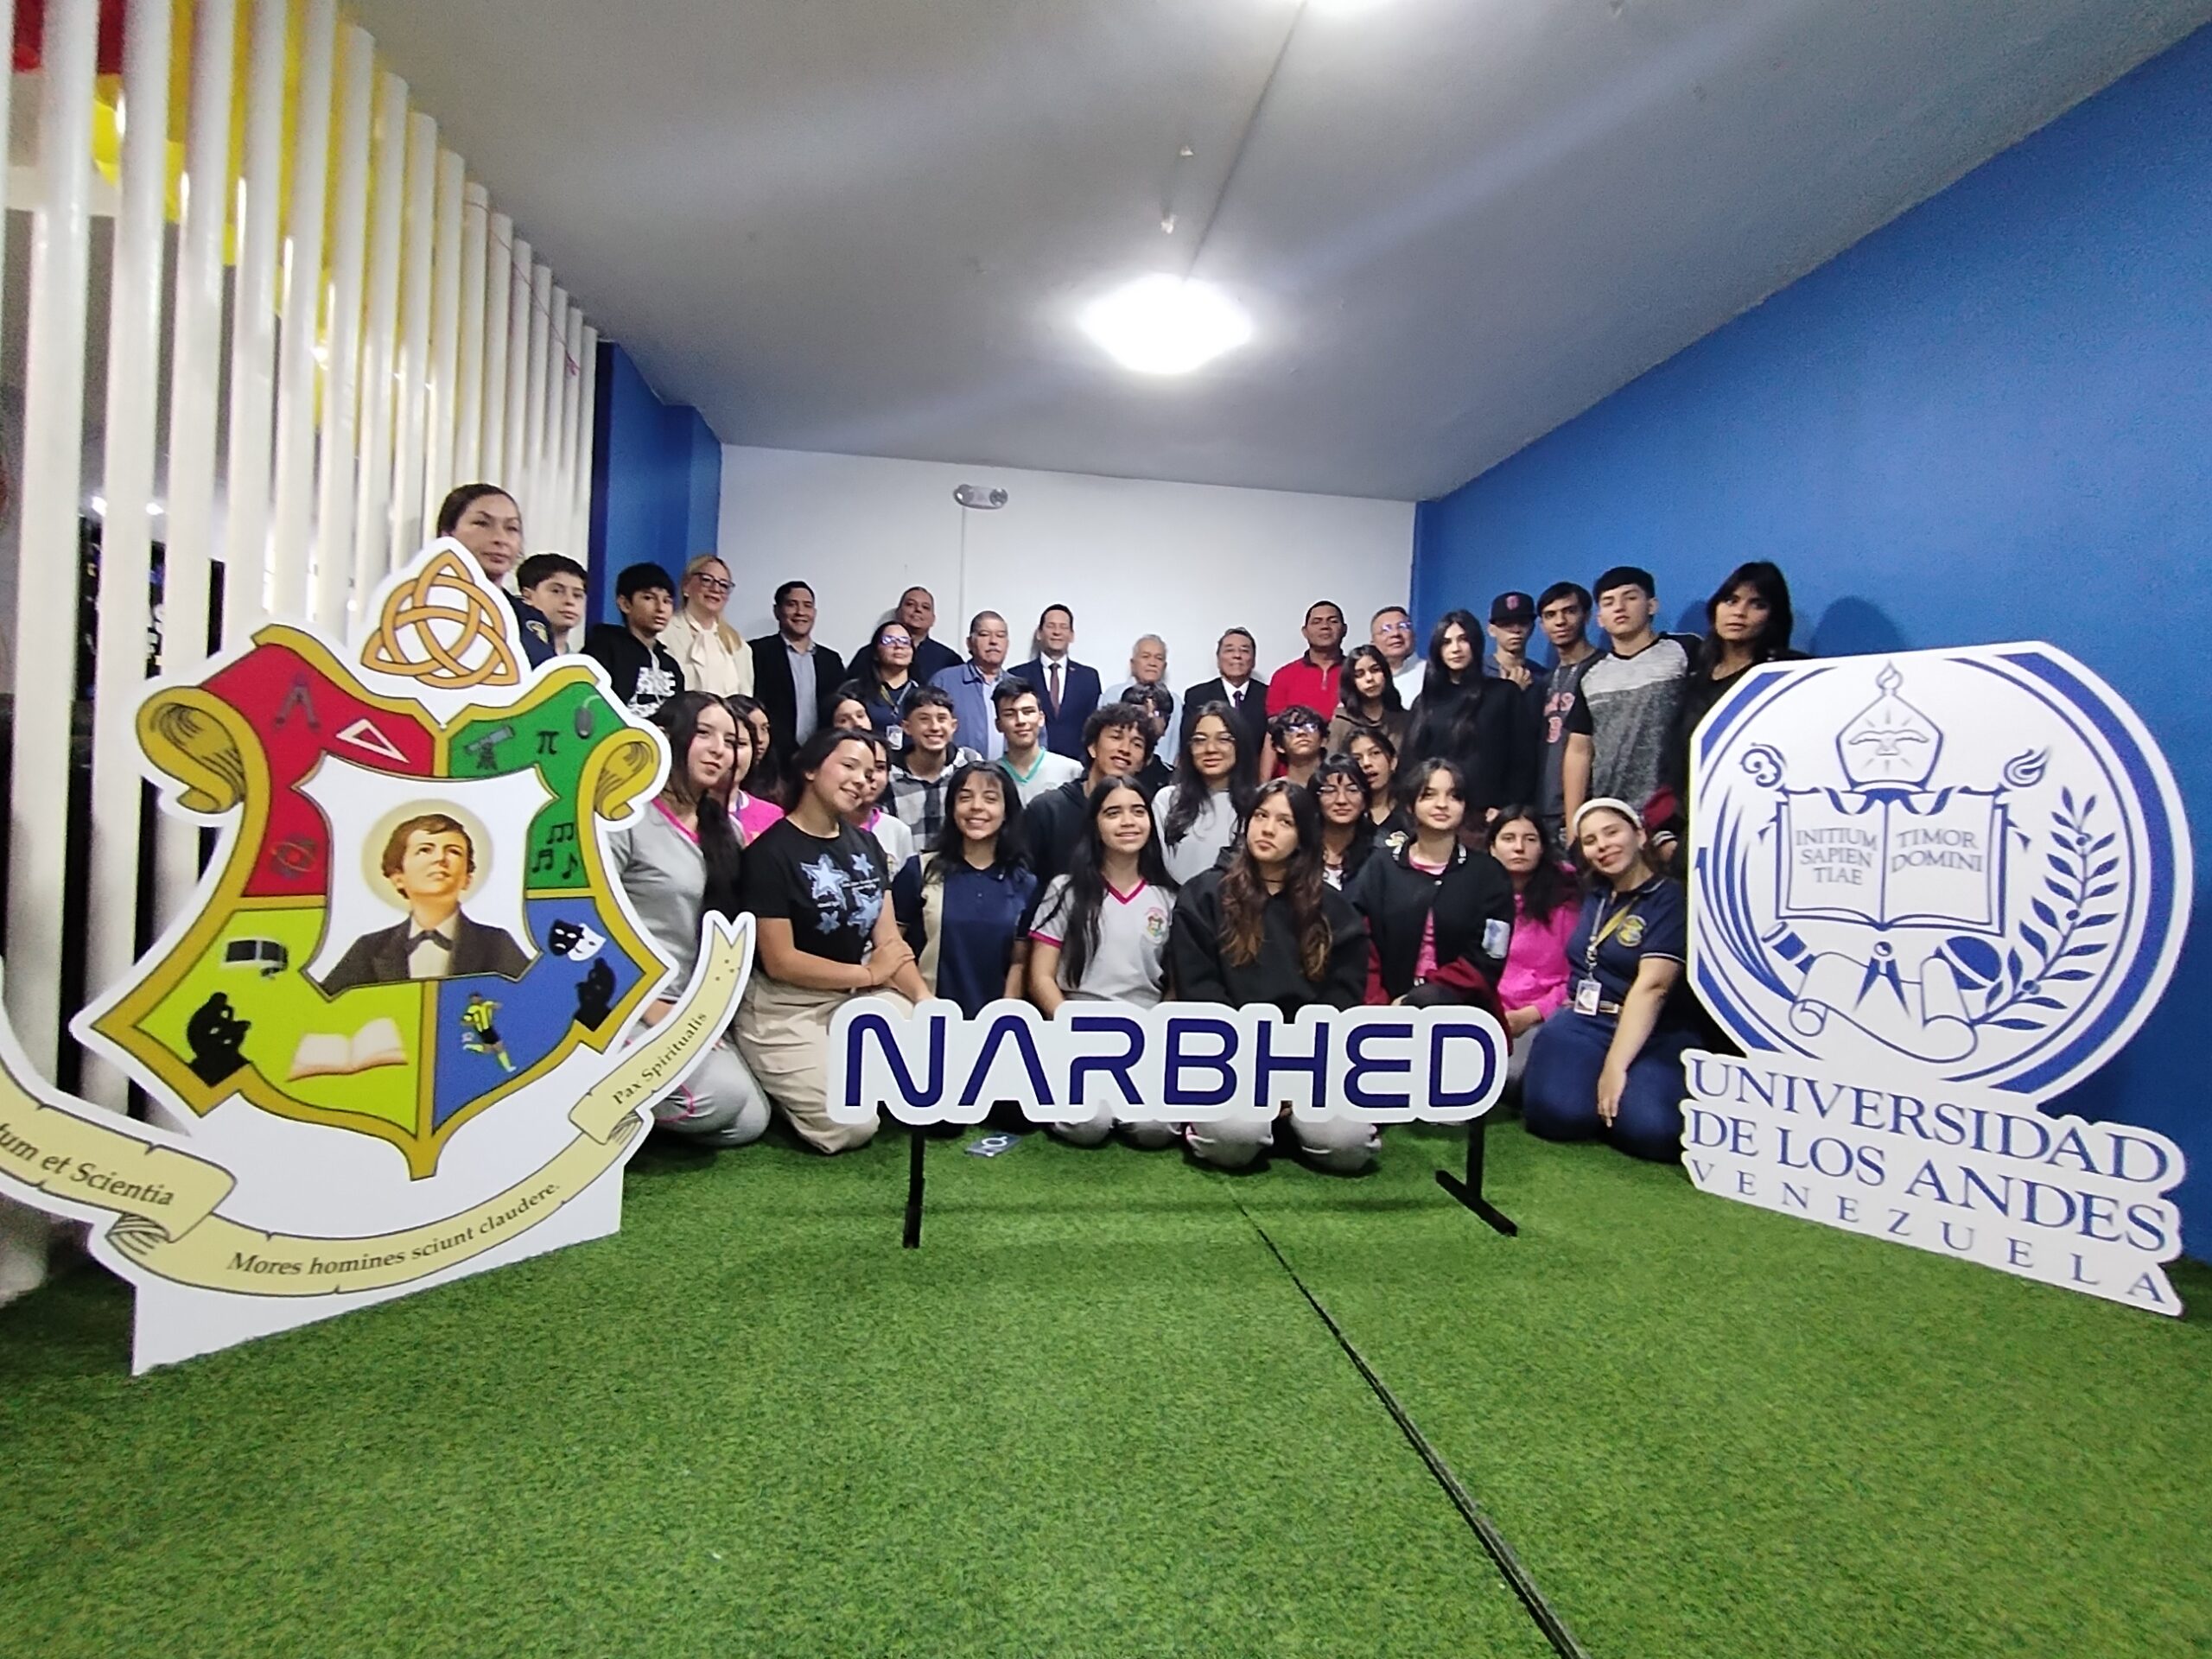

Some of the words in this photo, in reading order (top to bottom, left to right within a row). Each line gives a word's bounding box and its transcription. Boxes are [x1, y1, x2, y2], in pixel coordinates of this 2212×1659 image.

[1796, 827, 1877, 850] INITIUM
[1800, 847, 1872, 868] SAPIEN
[1891, 850, 1983, 873] DOMINI
[1897, 829, 1979, 849] TIMOR
[1814, 867, 1863, 886] TIAE
[613, 1081, 642, 1105] Pax
[641, 1013, 707, 1082] Spiritualis
[845, 1014, 1495, 1108] NARBHED
[1691, 1058, 2169, 1183] UNIVERSIDAD
[41, 1154, 72, 1174] et
[69, 1162, 175, 1206] Scientia
[1690, 1109, 1759, 1157] DE
[1777, 1127, 1885, 1186] LOS
[1904, 1159, 2166, 1252] ANDES
[226, 1252, 302, 1275] Mores
[308, 1252, 405, 1275] homines
[411, 1227, 474, 1261] sciunt
[479, 1185, 561, 1235] claudere.
[1692, 1160, 2165, 1304] VENEZUELA
